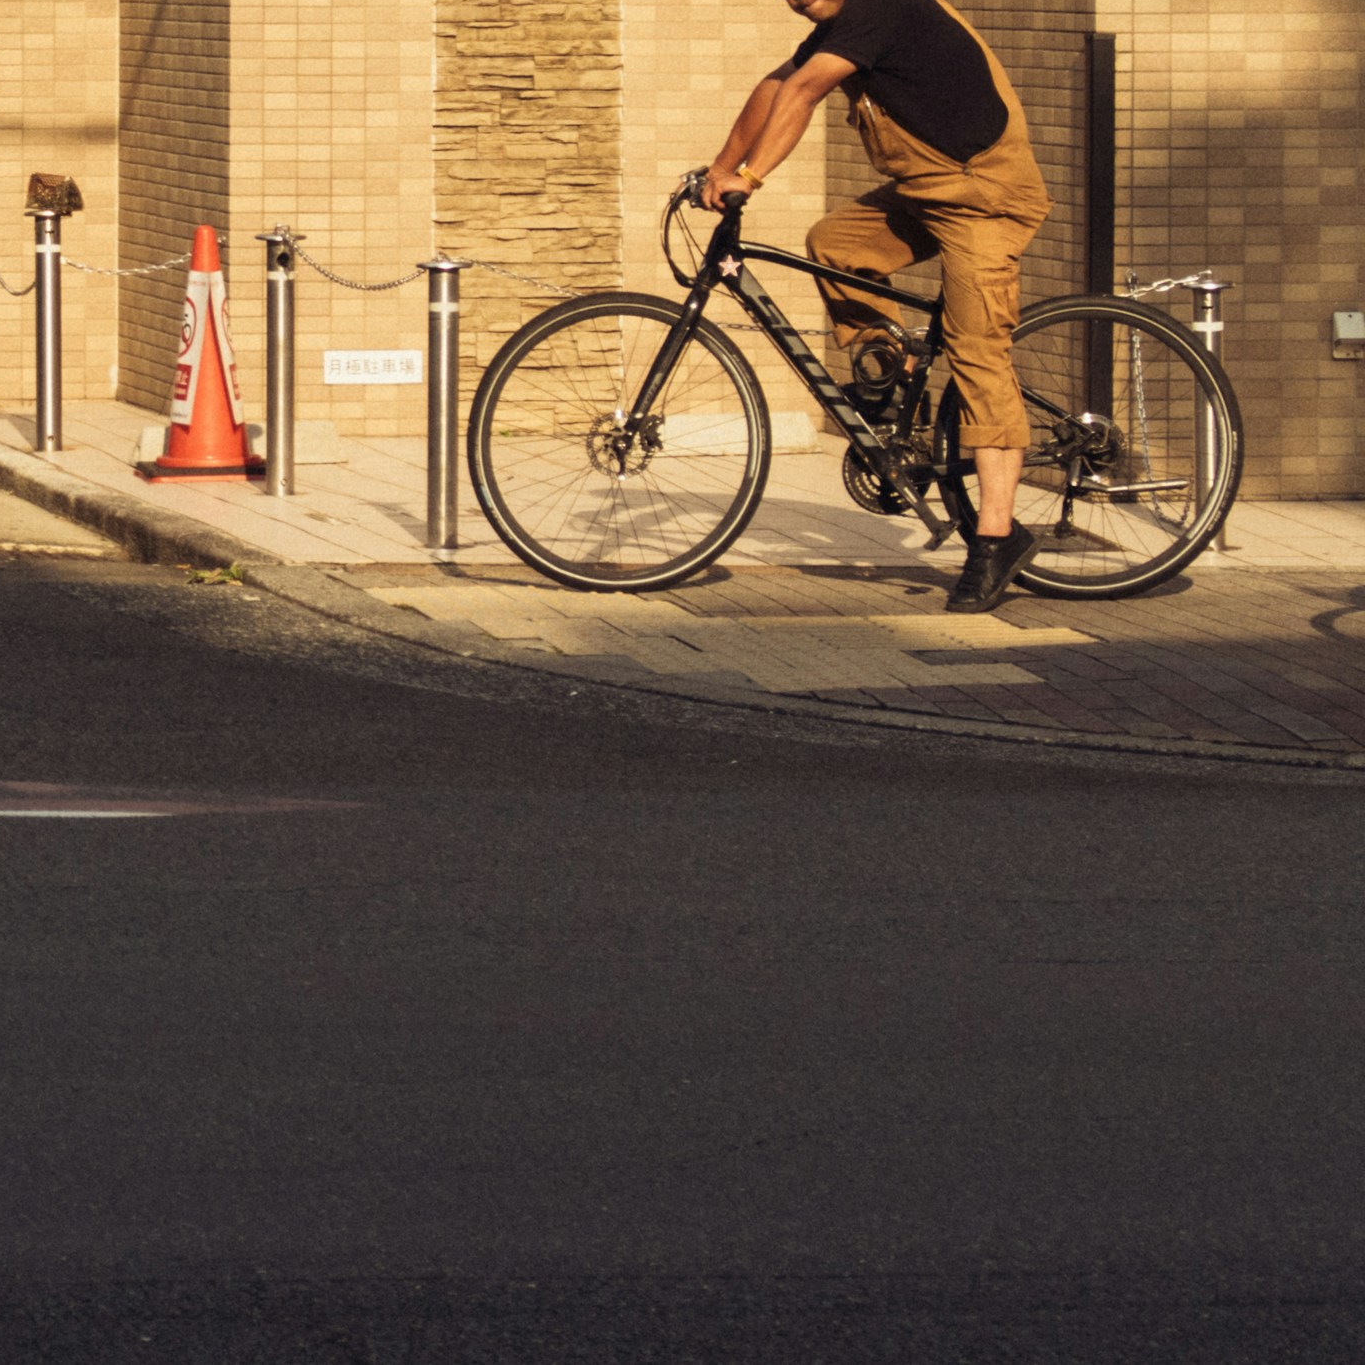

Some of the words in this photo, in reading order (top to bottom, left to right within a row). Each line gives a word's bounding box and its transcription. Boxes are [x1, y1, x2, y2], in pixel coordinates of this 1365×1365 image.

[328, 357, 415, 376] 月極駐車場
